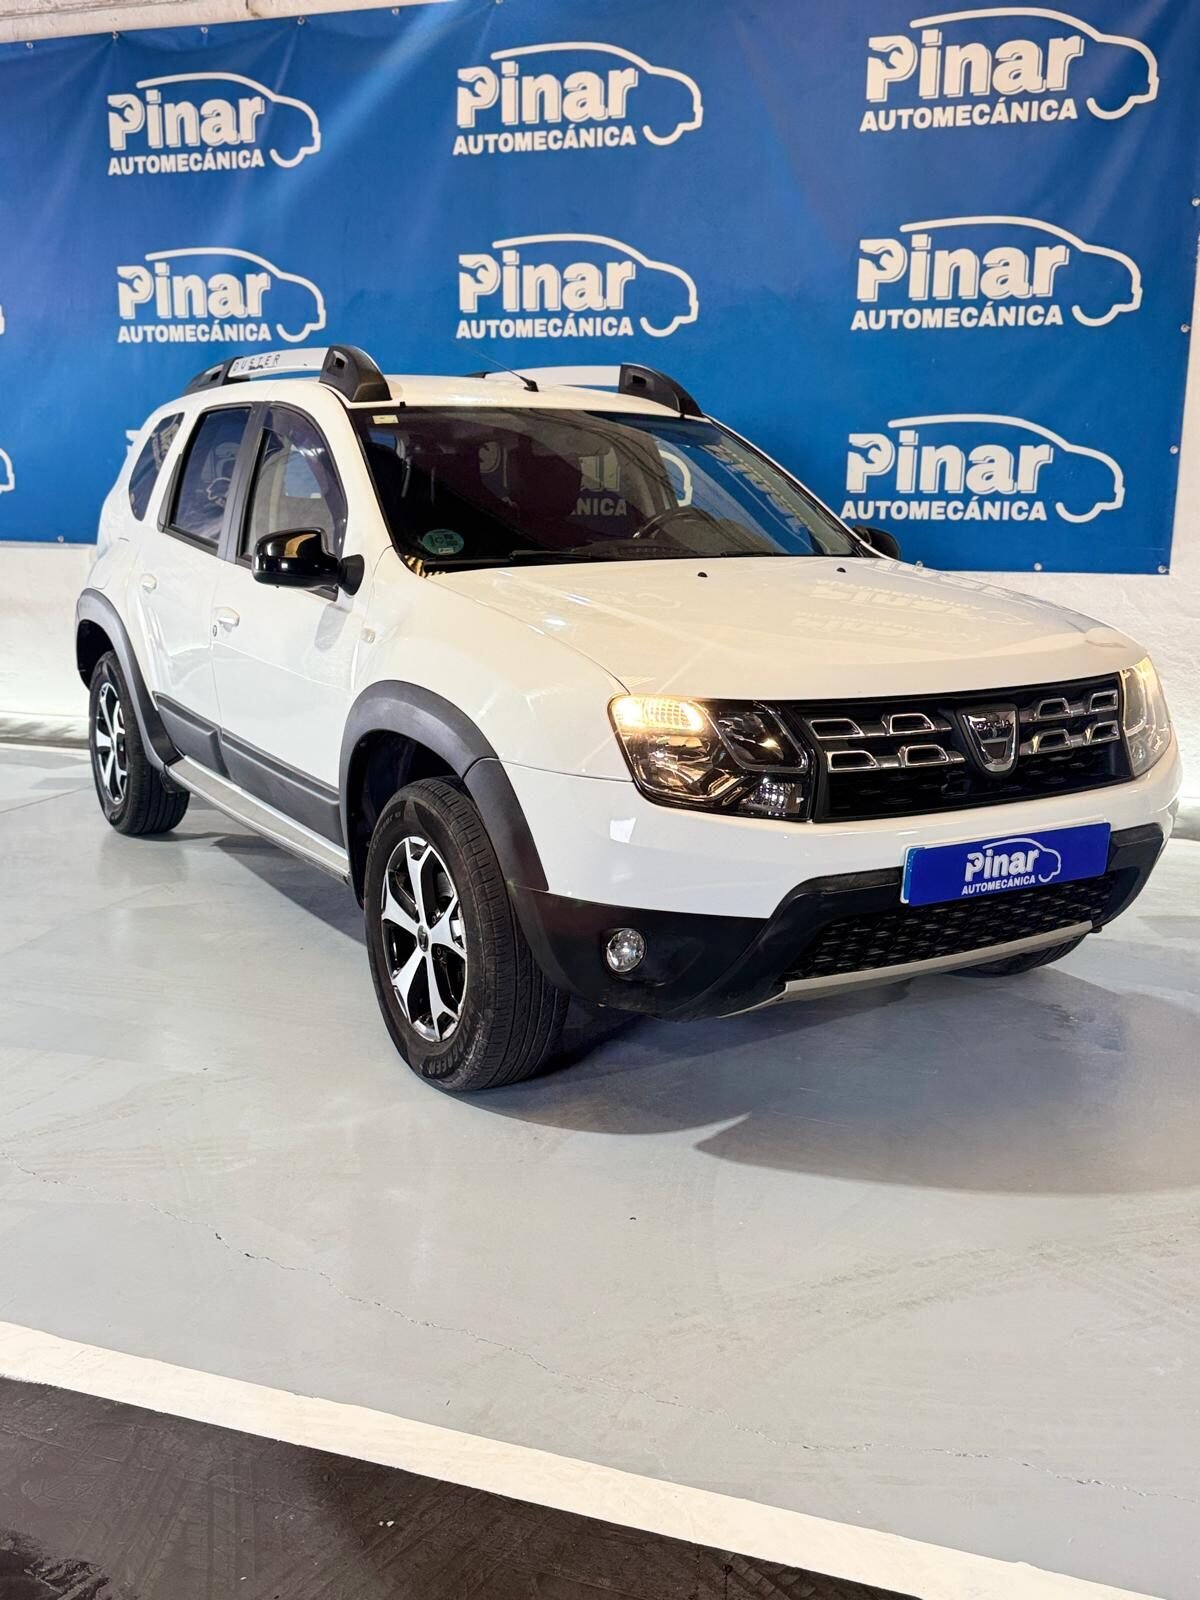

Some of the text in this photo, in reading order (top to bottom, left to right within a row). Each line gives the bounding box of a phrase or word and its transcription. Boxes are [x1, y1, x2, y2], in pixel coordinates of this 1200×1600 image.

[863, 29, 1084, 102] Pinar
[455, 61, 640, 130] Pinar
[107, 88, 266, 153] Pinar
[860, 97, 1077, 132] AUTOMECÁNICA
[453, 124, 636, 156] AUTOMECÁNICA
[108, 148, 265, 177] AUTOMECÁNICA
[458, 250, 637, 314] Pinar
[856, 233, 1070, 303] Pinar
[117, 261, 271, 320] Pinar
[117, 315, 272, 344] AUTOMECÁNICA
[456, 312, 634, 340] AUTOMECÁNICA
[851, 301, 1063, 332] AUTOMECÁNICA
[846, 430, 1055, 495] Pinar
[840, 495, 1047, 522] AUTOMECÁNICA
[964, 848, 1040, 882] Pinar
[961, 872, 1037, 896] AUTOMECÁNICA
